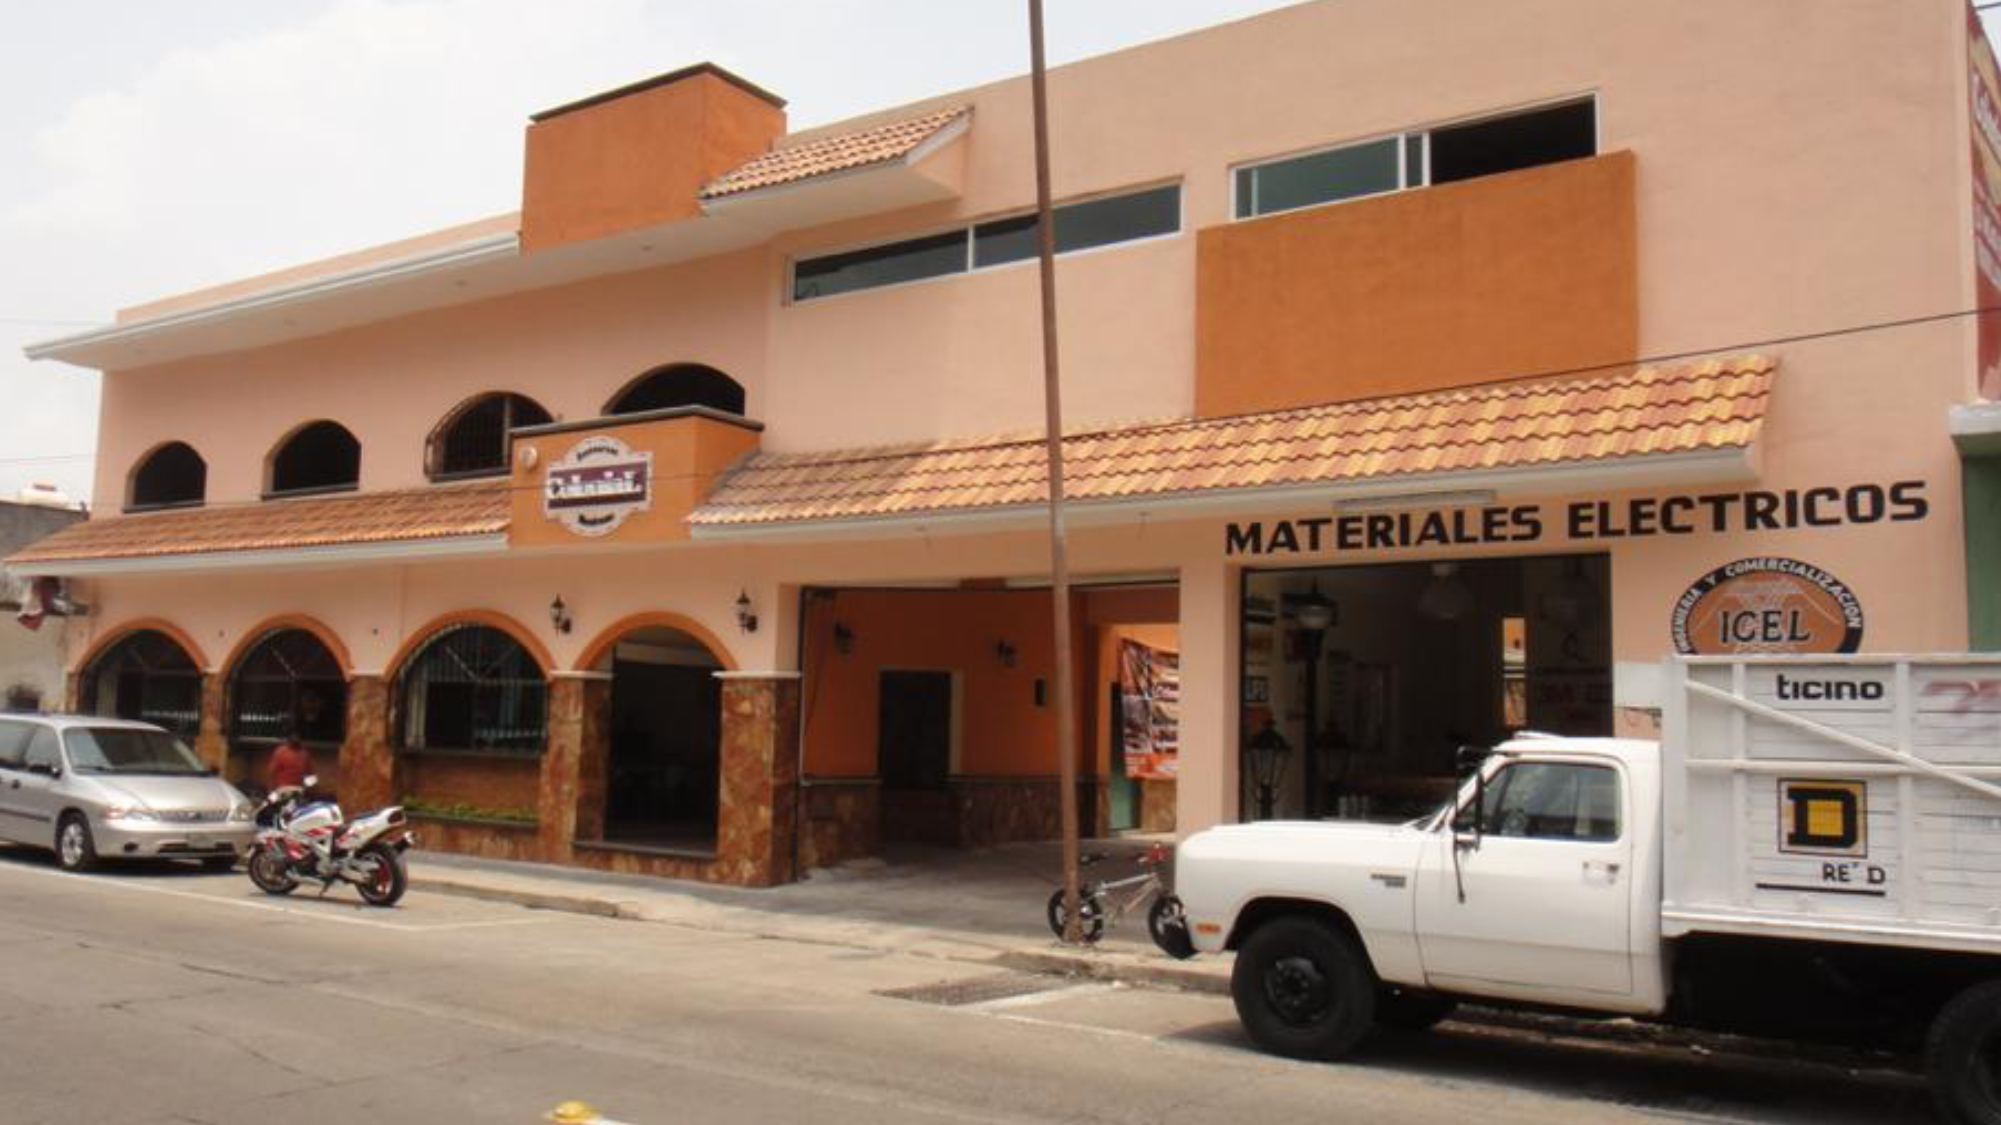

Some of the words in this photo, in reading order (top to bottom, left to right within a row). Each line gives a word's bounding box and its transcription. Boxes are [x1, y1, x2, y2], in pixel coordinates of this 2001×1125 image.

[1225, 505, 1542, 555] MATERIALES
[1568, 481, 1928, 539] ELECTRICOS
[1704, 573, 1718, 587] Y
[1724, 557, 1861, 629] COMERCIALIZACION
[1719, 609, 1810, 644] ICEL
[1777, 673, 1884, 700] ticino
